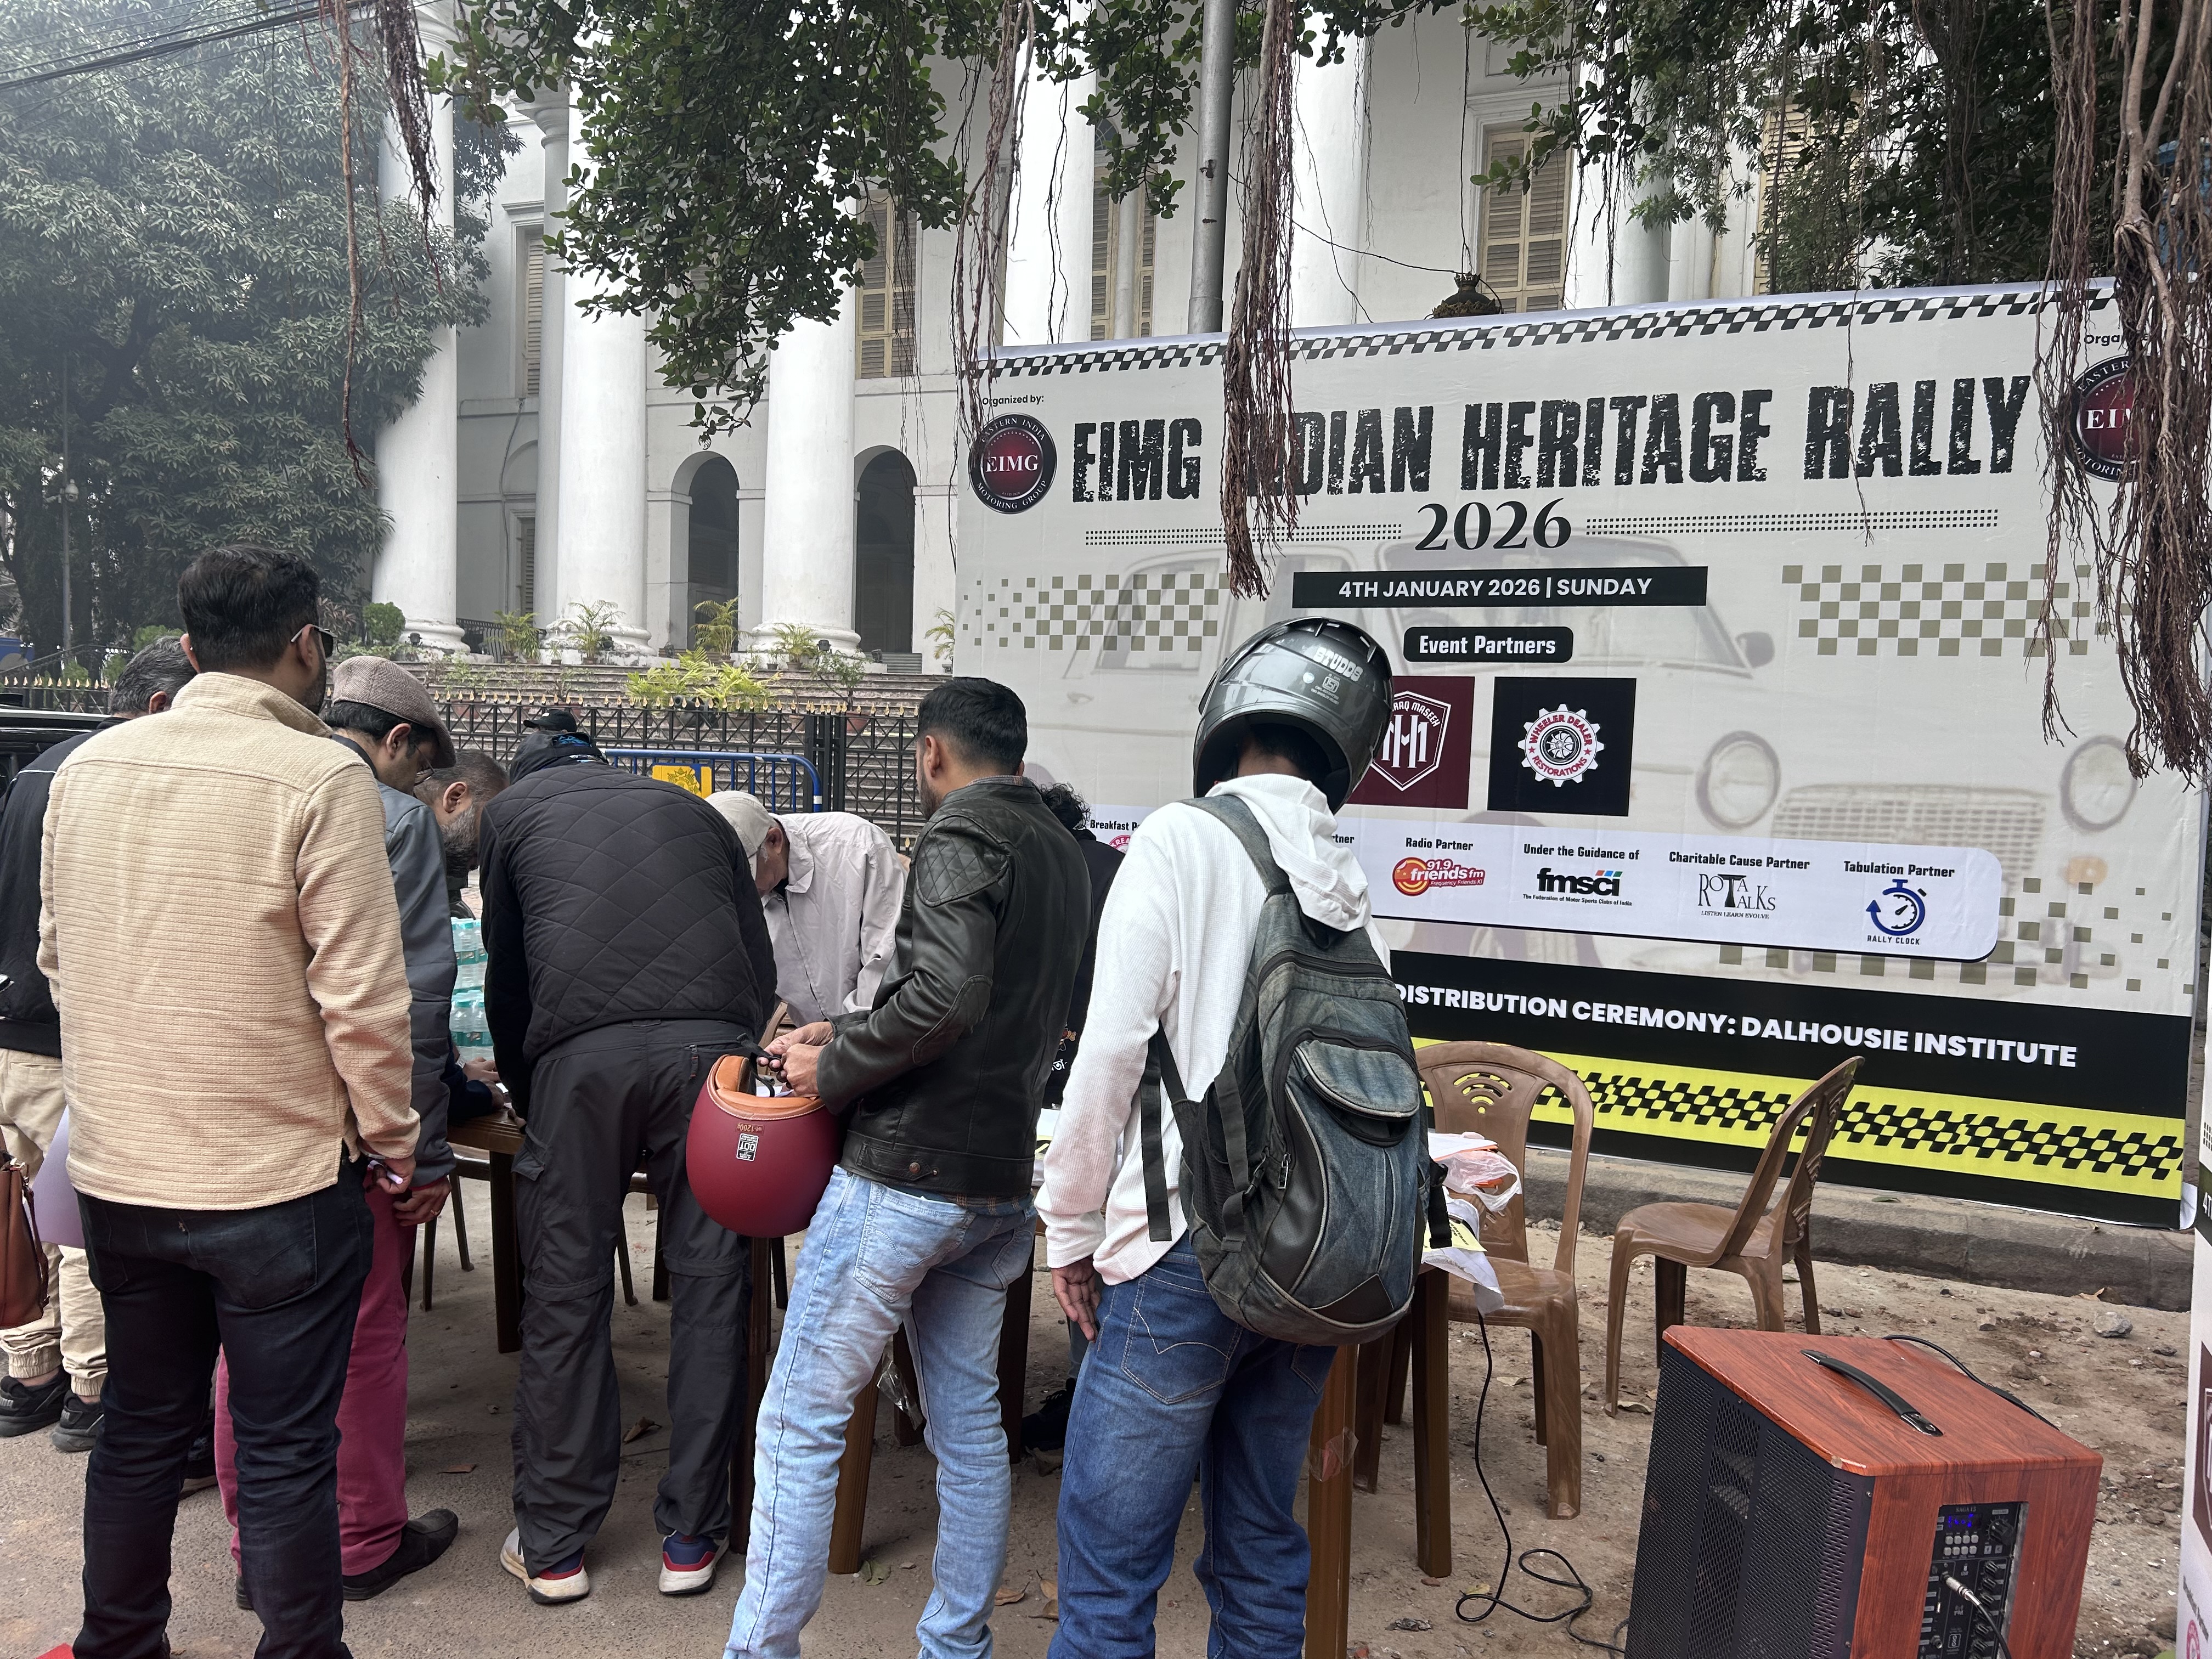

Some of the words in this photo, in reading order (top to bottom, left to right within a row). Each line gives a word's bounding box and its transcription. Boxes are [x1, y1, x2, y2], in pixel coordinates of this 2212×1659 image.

[2078, 360, 2130, 392] EASTER
[982, 394, 1028, 407] Organized
[1030, 394, 1044, 405] by:
[1022, 419, 1045, 441] INDIA
[1073, 419, 1201, 502] EIMG
[1248, 406, 1434, 496] DIAN
[1460, 390, 1773, 490] HERITAGE
[1804, 376, 2031, 480] RALLY
[985, 455, 1039, 472] EIMG
[977, 482, 1018, 509] MOTORING
[1022, 480, 1047, 506] GROUP
[1414, 498, 1572, 551] 2026
[1339, 582, 1378, 597] 4TH
[1383, 580, 1483, 597] JANUARY
[1488, 579, 1539, 596] 2026
[1556, 578, 1652, 595] SUNDAY
[1419, 635, 1468, 654] Event
[1474, 635, 1556, 654] Partners
[1313, 646, 1363, 682] STUDDS
[1411, 702, 1441, 727] MASEEH
[1528, 714, 1565, 744] WHEELER
[1567, 715, 1593, 747] DEALER
[1532, 755, 1587, 776] RESTORATIONS
[1090, 820, 1129, 831] Breakfast
[1332, 834, 1355, 844] tner
[1406, 837, 1432, 848] Radio
[1436, 839, 1474, 850] Partner
[1523, 844, 1554, 855] Under
[1558, 845, 1574, 856] the
[1578, 847, 1625, 859] Guidance
[1628, 850, 1639, 860] of
[1669, 851, 1726, 865] Charitable
[1729, 855, 1762, 867] Cause
[1766, 856, 1810, 870] Partner
[1410, 866, 1468, 881] friends
[1469, 870, 1483, 878] fm
[1427, 860, 1452, 871] 91.9
[1844, 861, 1904, 874] Tabulation
[1908, 864, 1955, 877] Partner
[1537, 867, 1622, 897] fmsci
[1867, 935, 1892, 943] RALLY
[1395, 984, 1567, 1019] DISTRIBUTION
[1572, 1001, 1736, 1035] CEREMONY:
[1741, 1017, 1908, 1052] DALHOUSIE
[1915, 1031, 2077, 1068] INSTITUTE
[740, 1142, 755, 1151] DOT
